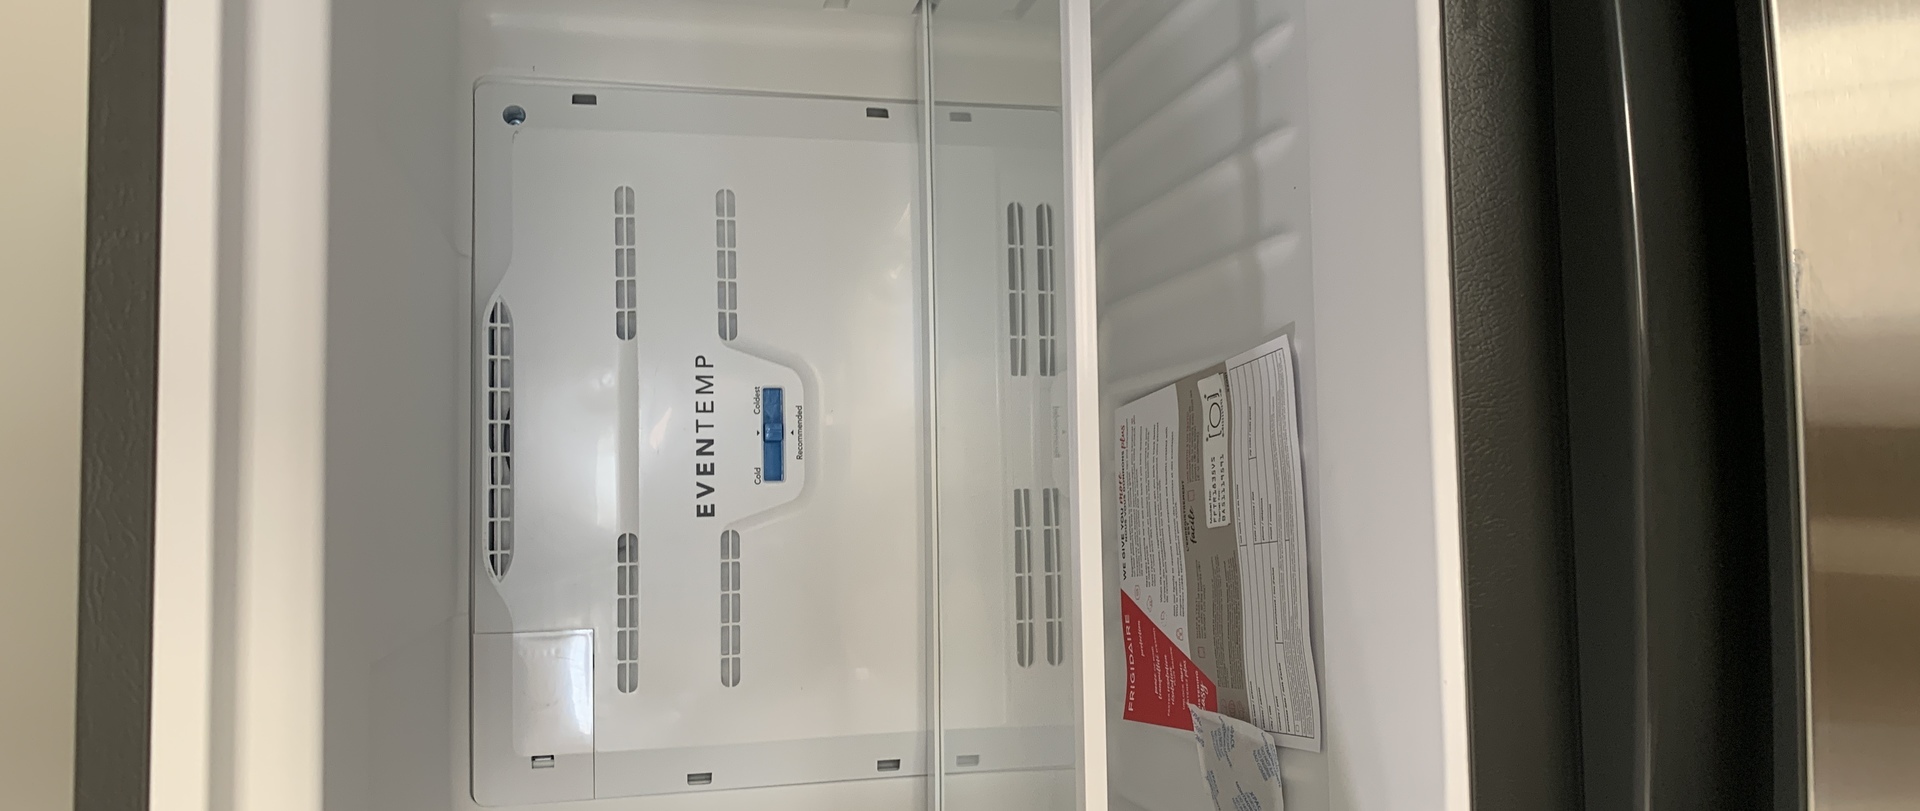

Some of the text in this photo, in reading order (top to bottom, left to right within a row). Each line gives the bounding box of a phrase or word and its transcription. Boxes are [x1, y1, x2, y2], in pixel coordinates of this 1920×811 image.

[753, 386, 761, 415] Coldest
[694, 354, 716, 518] EVENTEMP
[796, 405, 804, 460] Recommended
[1188, 505, 1197, 544] facile
[1122, 563, 1127, 580] WE
[1137, 620, 1145, 657] protection
[1124, 614, 1136, 712] FRIGIDAIRE
